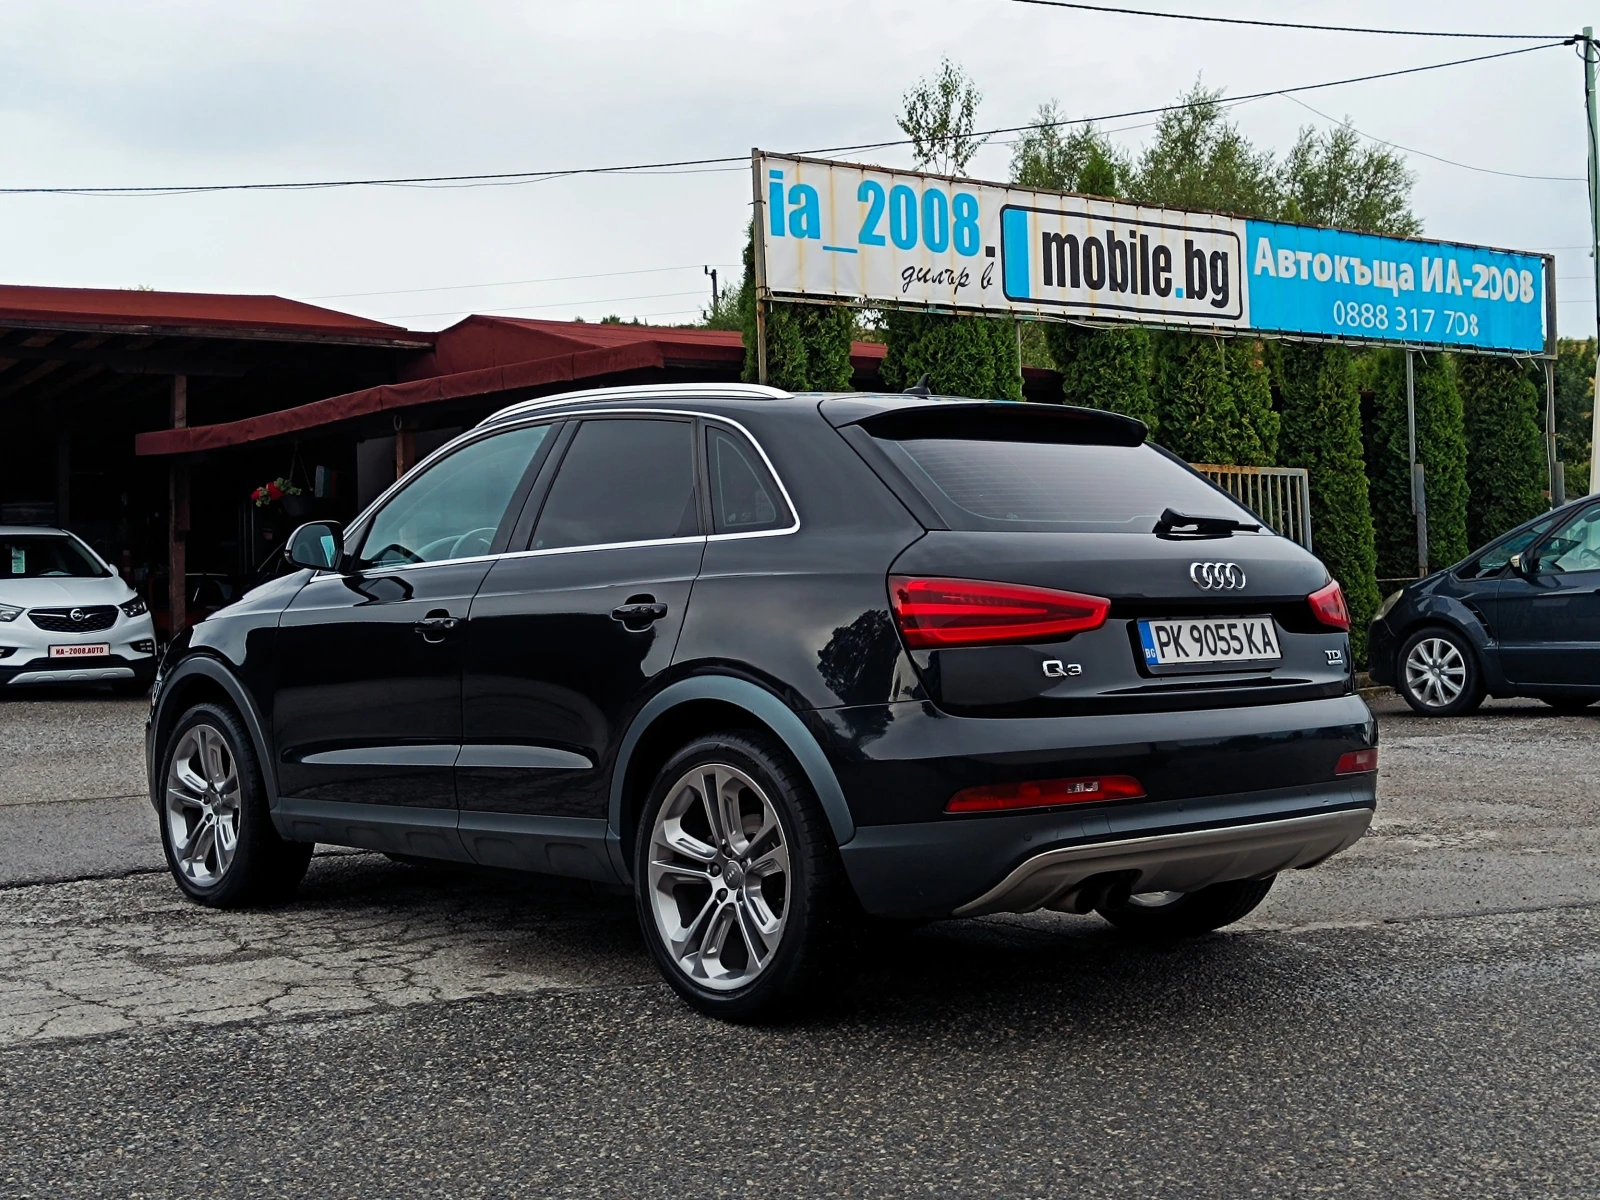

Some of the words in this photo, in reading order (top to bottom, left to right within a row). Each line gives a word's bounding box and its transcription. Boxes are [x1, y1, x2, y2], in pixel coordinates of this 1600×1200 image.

[901, 261, 971, 294] дилър
[1042, 229, 1229, 307] mobile.bg
[1253, 237, 1415, 297] Автокъща
[1421, 256, 1535, 304] ИА-2008
[1333, 300, 1389, 330] 0888
[1395, 306, 1436, 333] 317
[1443, 310, 1479, 337] 708
[1145, 648, 1156, 658] BG
[1154, 625, 1190, 659] PK
[1189, 623, 1244, 656] 9055
[1243, 622, 1276, 654] KA
[1324, 649, 1342, 660] TDI
[1042, 659, 1083, 678] Q3
